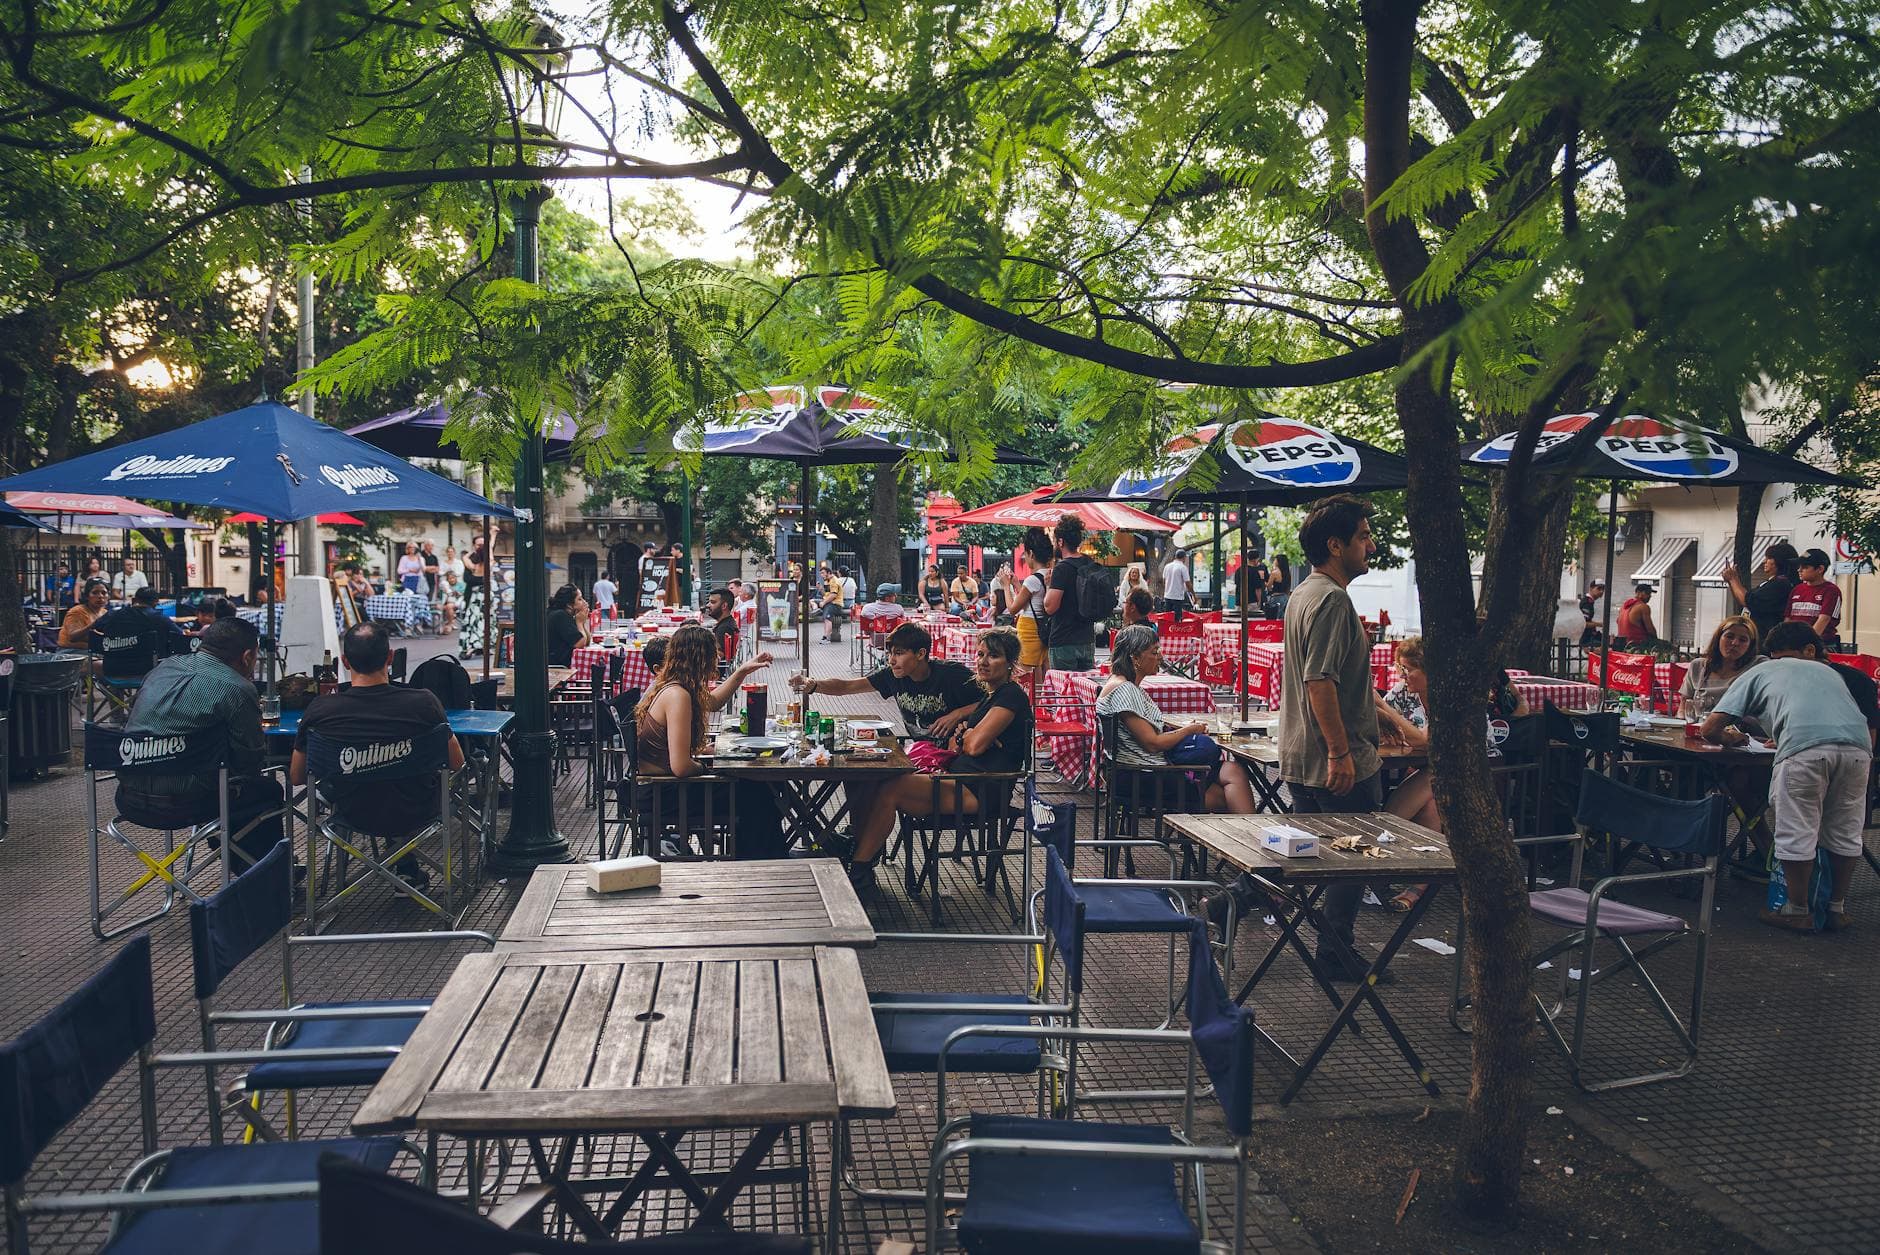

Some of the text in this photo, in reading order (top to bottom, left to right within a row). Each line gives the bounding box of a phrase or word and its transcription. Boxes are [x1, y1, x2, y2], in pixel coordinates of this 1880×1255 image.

[1239, 441, 1345, 464] PEPSI
[1604, 437, 1725, 456] PEPSI
[101, 454, 236, 481] Quilmes
[319, 463, 400, 495] Quilmes
[102, 635, 139, 652] Quilmes
[1611, 668, 1643, 686] Coca-Cola
[119, 735, 187, 766] Quilmes
[339, 738, 413, 775] Quilmes
